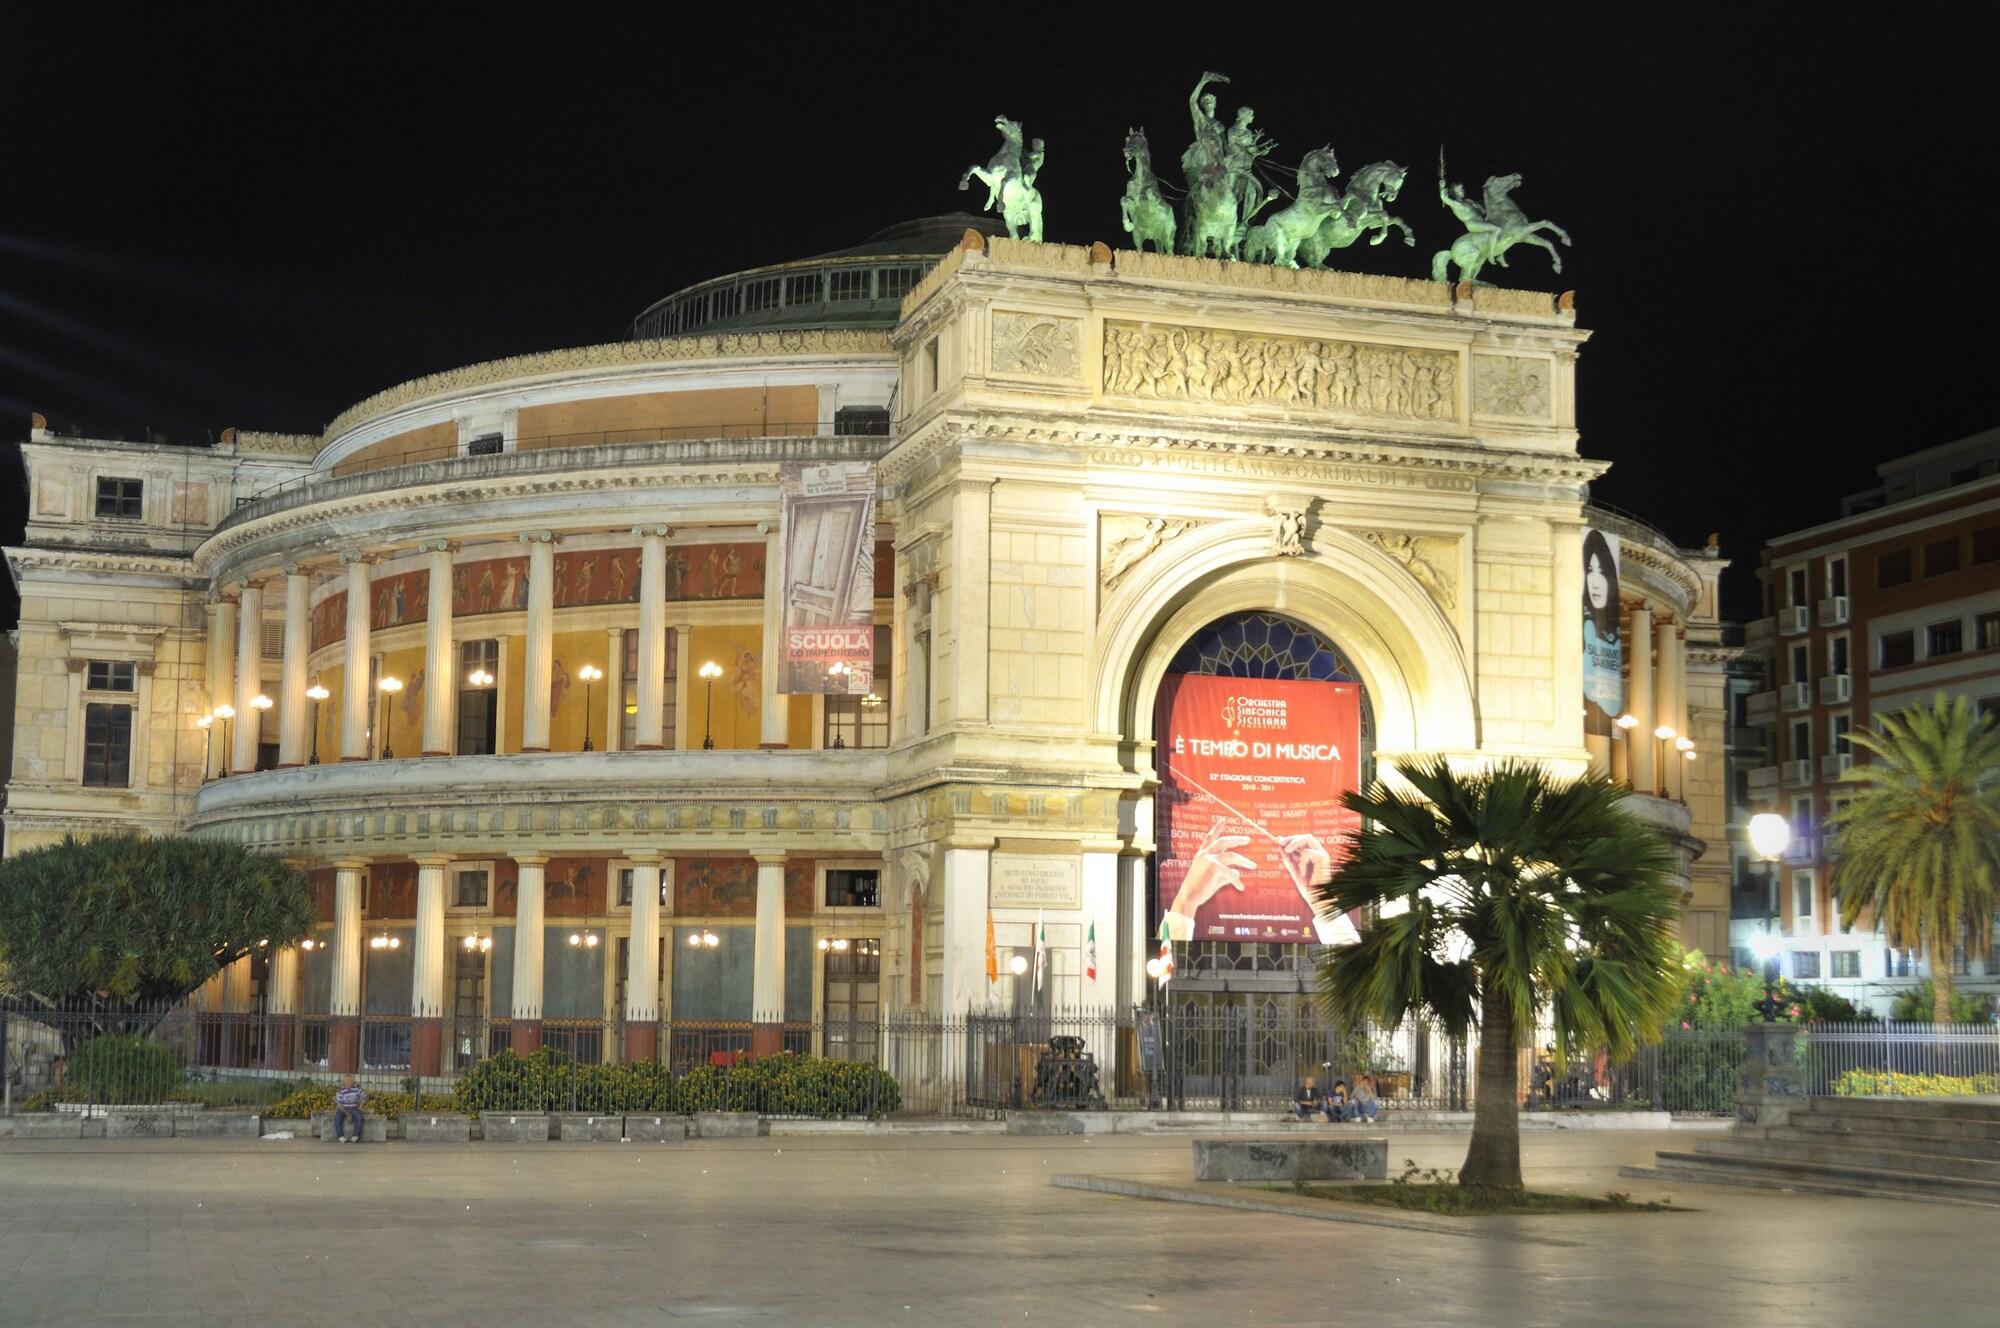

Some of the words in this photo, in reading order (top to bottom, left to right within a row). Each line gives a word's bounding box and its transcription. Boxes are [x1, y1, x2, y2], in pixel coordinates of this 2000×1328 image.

[1166, 455, 1278, 476] POLITEAMA
[1295, 465, 1398, 486] GARIBALDI
[790, 634, 870, 649] SCUOLA
[790, 649, 803, 657] LO
[806, 649, 870, 657] IMPEDIREMO
[1237, 696, 1287, 708] ORCHESTRA
[1237, 706, 1287, 717] SINFONICA
[1237, 715, 1287, 726] SICILIANA
[1175, 734, 1185, 754] È
[1189, 739, 1249, 758] TEMPO
[1253, 742, 1271, 759] DI
[1276, 743, 1341, 761] MUSICA
[1220, 773, 1253, 783] STAGIONE
[1253, 774, 1306, 784] CONCERTISTICA
[1241, 783, 1256, 791] 2010
